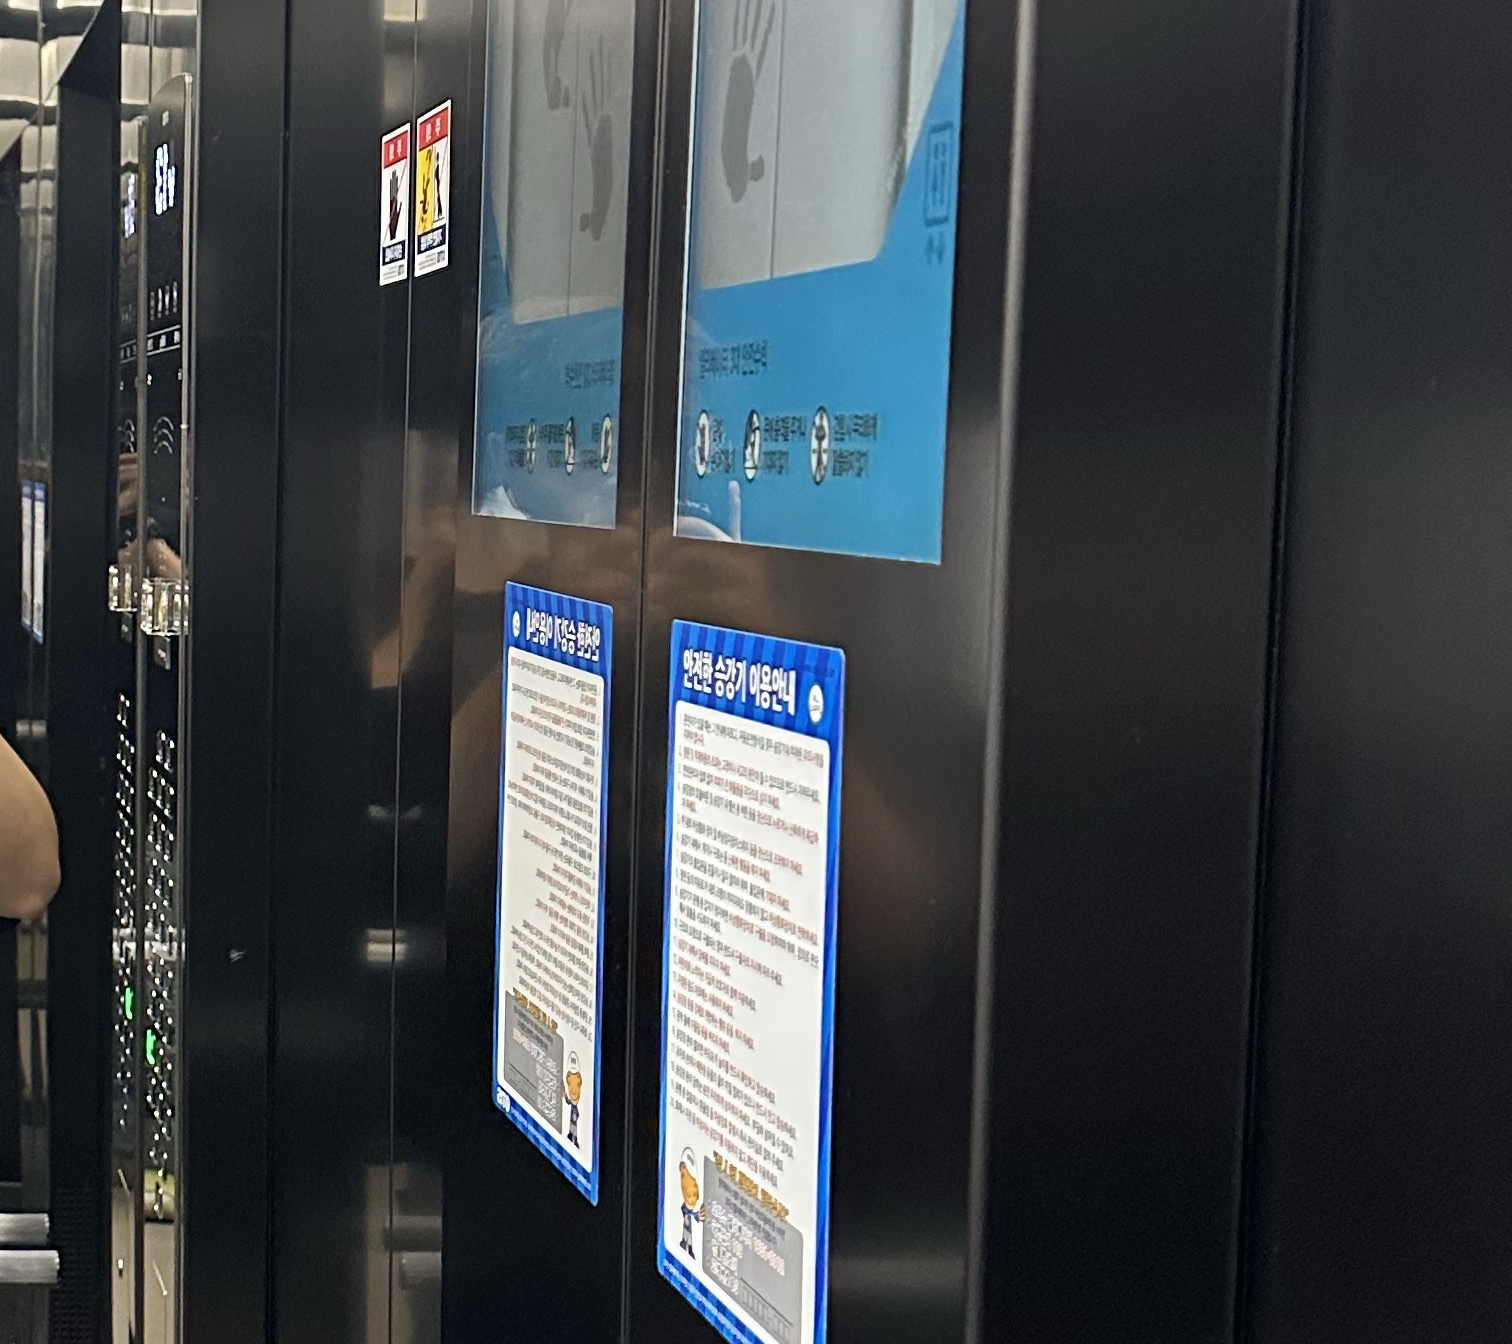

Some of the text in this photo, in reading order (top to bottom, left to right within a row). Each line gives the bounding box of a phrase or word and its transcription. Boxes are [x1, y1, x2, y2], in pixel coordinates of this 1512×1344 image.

[683, 648, 796, 716] 안전한 승강기 이용안내
